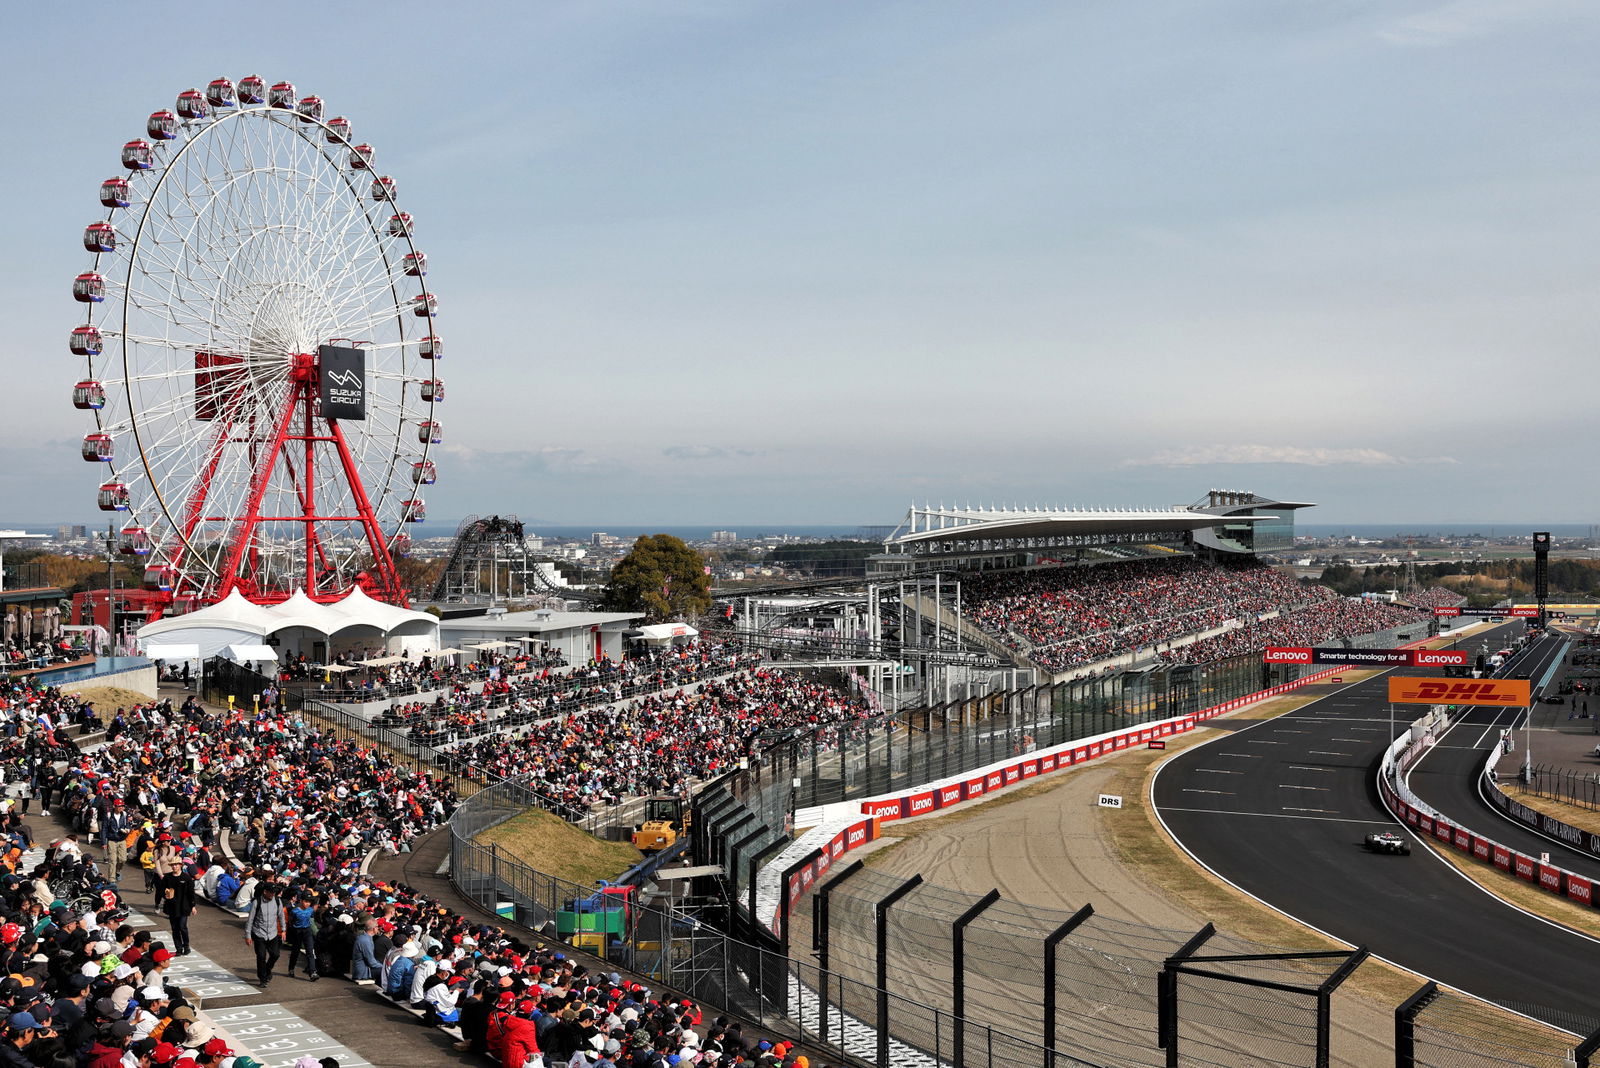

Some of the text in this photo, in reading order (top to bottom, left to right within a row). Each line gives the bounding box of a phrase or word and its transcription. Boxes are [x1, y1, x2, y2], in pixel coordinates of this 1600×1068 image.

[330, 388, 361, 397] SUZUKA
[330, 396, 361, 404] CIRCUIT
[1266, 648, 1308, 660] Lenovo
[1319, 652, 1407, 662] Smarter technology for all
[1418, 653, 1462, 664] Lenovo
[1417, 682, 1500, 701] DHL
[912, 796, 932, 812] Lenovo
[942, 789, 959, 803] Lenovo
[1101, 797, 1119, 806] DRS
[869, 804, 899, 816] Lenovo
[848, 828, 865, 844] Lenovo
[1543, 815, 1582, 845] QATAR AIRWAYS
[1456, 832, 1469, 848] Lenovo
[1475, 841, 1488, 857] Lenovo
[1494, 849, 1509, 867] Lenovo
[1516, 859, 1532, 877] Lenovo
[1540, 869, 1559, 888] Lenovo
[1568, 879, 1590, 899] Lenovo
